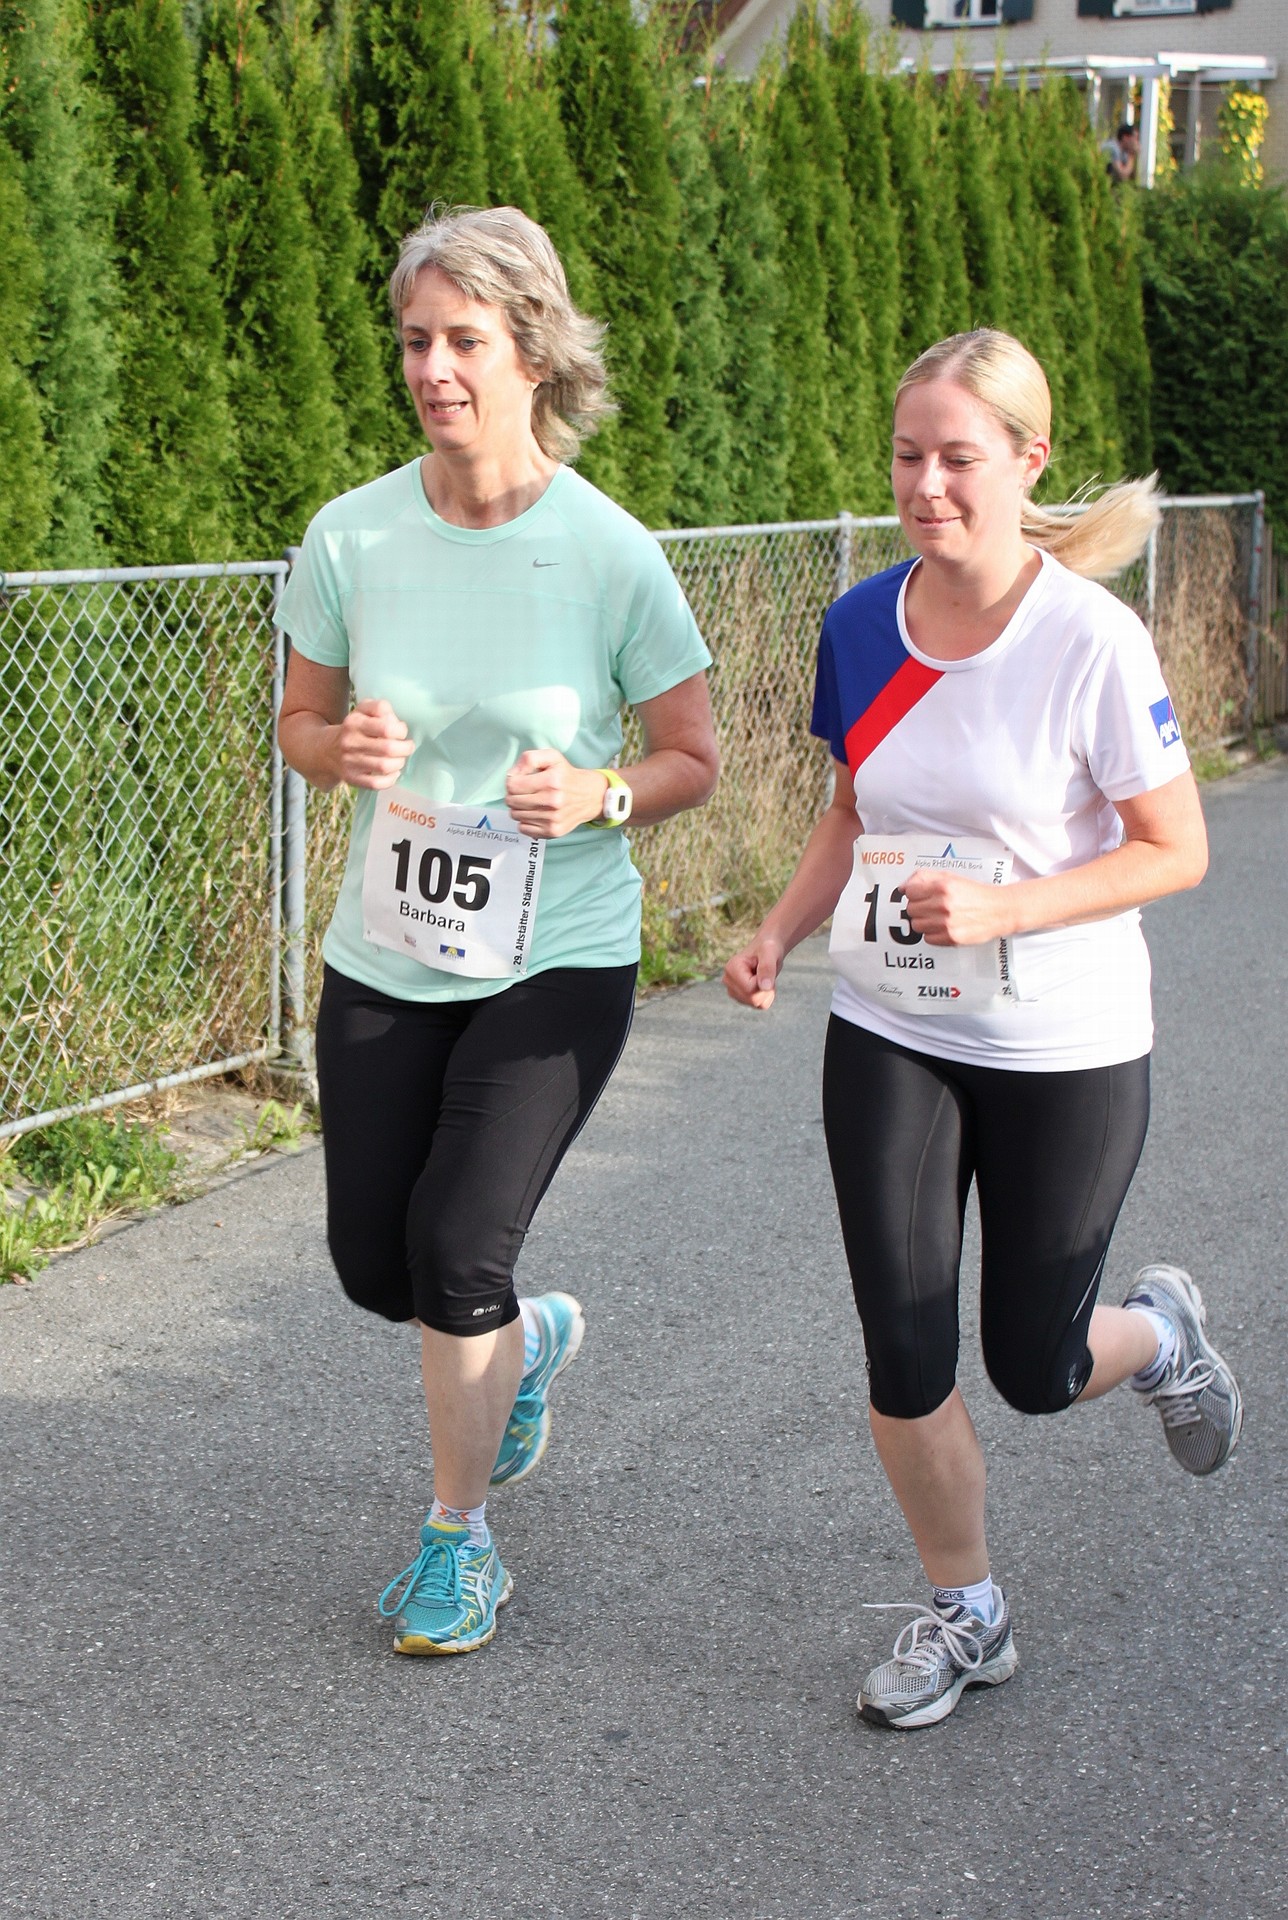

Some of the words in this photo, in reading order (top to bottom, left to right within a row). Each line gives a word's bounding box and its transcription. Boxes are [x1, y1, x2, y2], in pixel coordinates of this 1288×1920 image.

[388, 801, 437, 829] MIGROS
[446, 827, 465, 836] Alpha
[466, 829, 503, 842] RHEINTAL
[504, 835, 520, 843] Bank
[528, 837, 540, 859] 201
[860, 851, 906, 866] MIGROS
[391, 838, 492, 912] 105
[931, 859, 967, 870] RHEINTAL
[968, 863, 983, 871] Bank
[993, 860, 1005, 884] 2014
[399, 900, 466, 932] Barbara
[515, 911, 528, 951] Altstätter
[513, 953, 523, 966] 29.
[884, 951, 936, 970] Luzia
